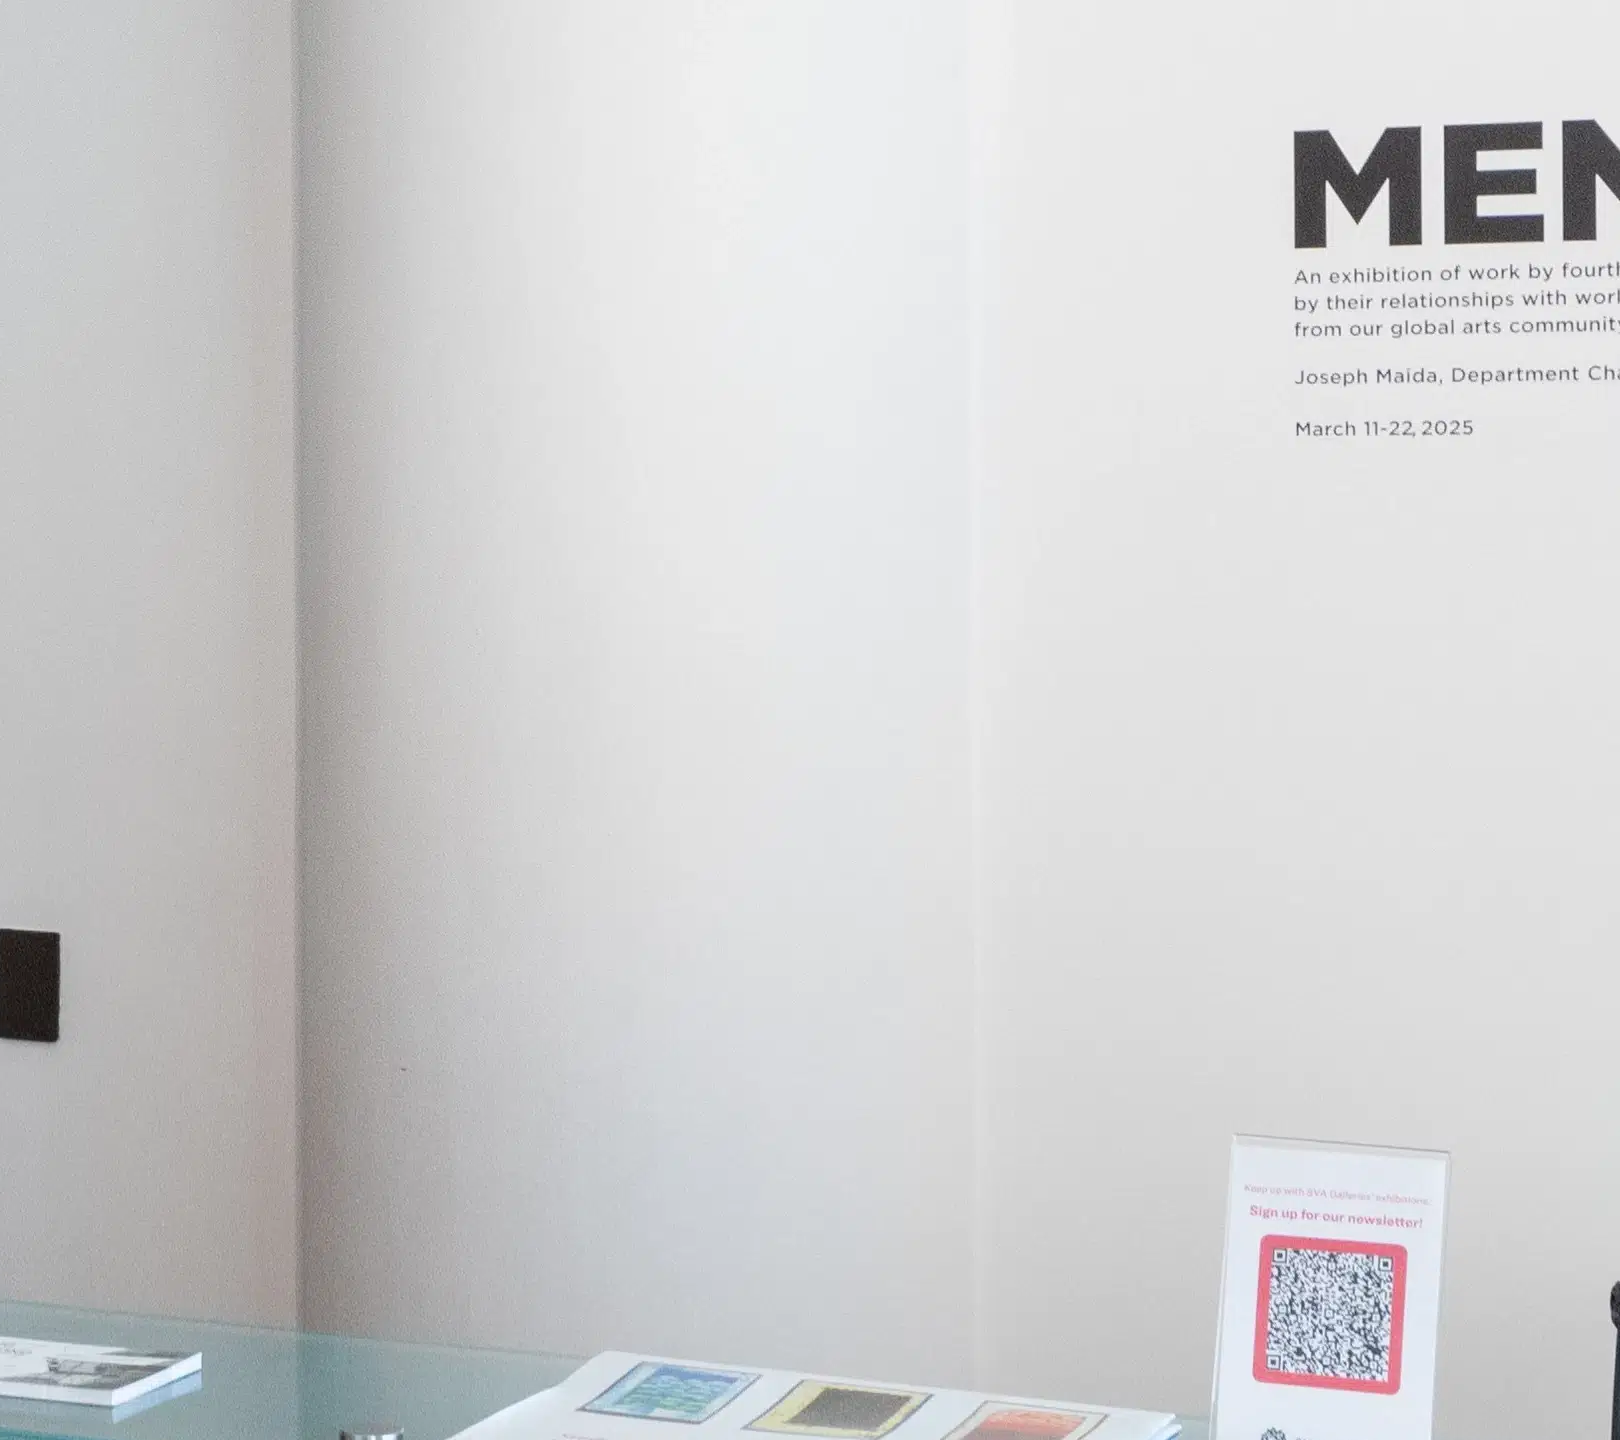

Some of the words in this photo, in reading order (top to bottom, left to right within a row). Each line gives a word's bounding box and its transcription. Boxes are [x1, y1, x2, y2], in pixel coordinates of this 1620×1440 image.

[1294, 269, 1322, 285] An
[1328, 267, 1432, 284] exhibition
[1439, 264, 1461, 281] of
[1468, 263, 1520, 280] work
[1528, 263, 1554, 282] by
[1294, 295, 1319, 314] by
[1326, 295, 1373, 311] their
[1380, 291, 1514, 310] relationships
[1522, 289, 1567, 306] with
[1294, 321, 1342, 337] from
[1349, 324, 1383, 337] our
[1390, 319, 1455, 339] global
[1462, 319, 1502, 335] arts
[1294, 368, 1368, 387] Joseph
[1376, 367, 1443, 385] Maida,
[1451, 366, 1579, 385] Department
[1295, 421, 1357, 437] March
[1421, 419, 1474, 436] 2025
[1244, 1184, 1267, 1195] Keep
[1270, 1187, 1282, 1196] up
[1284, 1187, 1305, 1197] with
[1307, 1188, 1327, 1199] SVA
[1250, 1204, 1278, 1221] Sign
[1282, 1207, 1297, 1221] up
[1301, 1208, 1318, 1222] for
[1323, 1211, 1343, 1223] our
[1348, 1213, 1423, 1229] newsletter!
